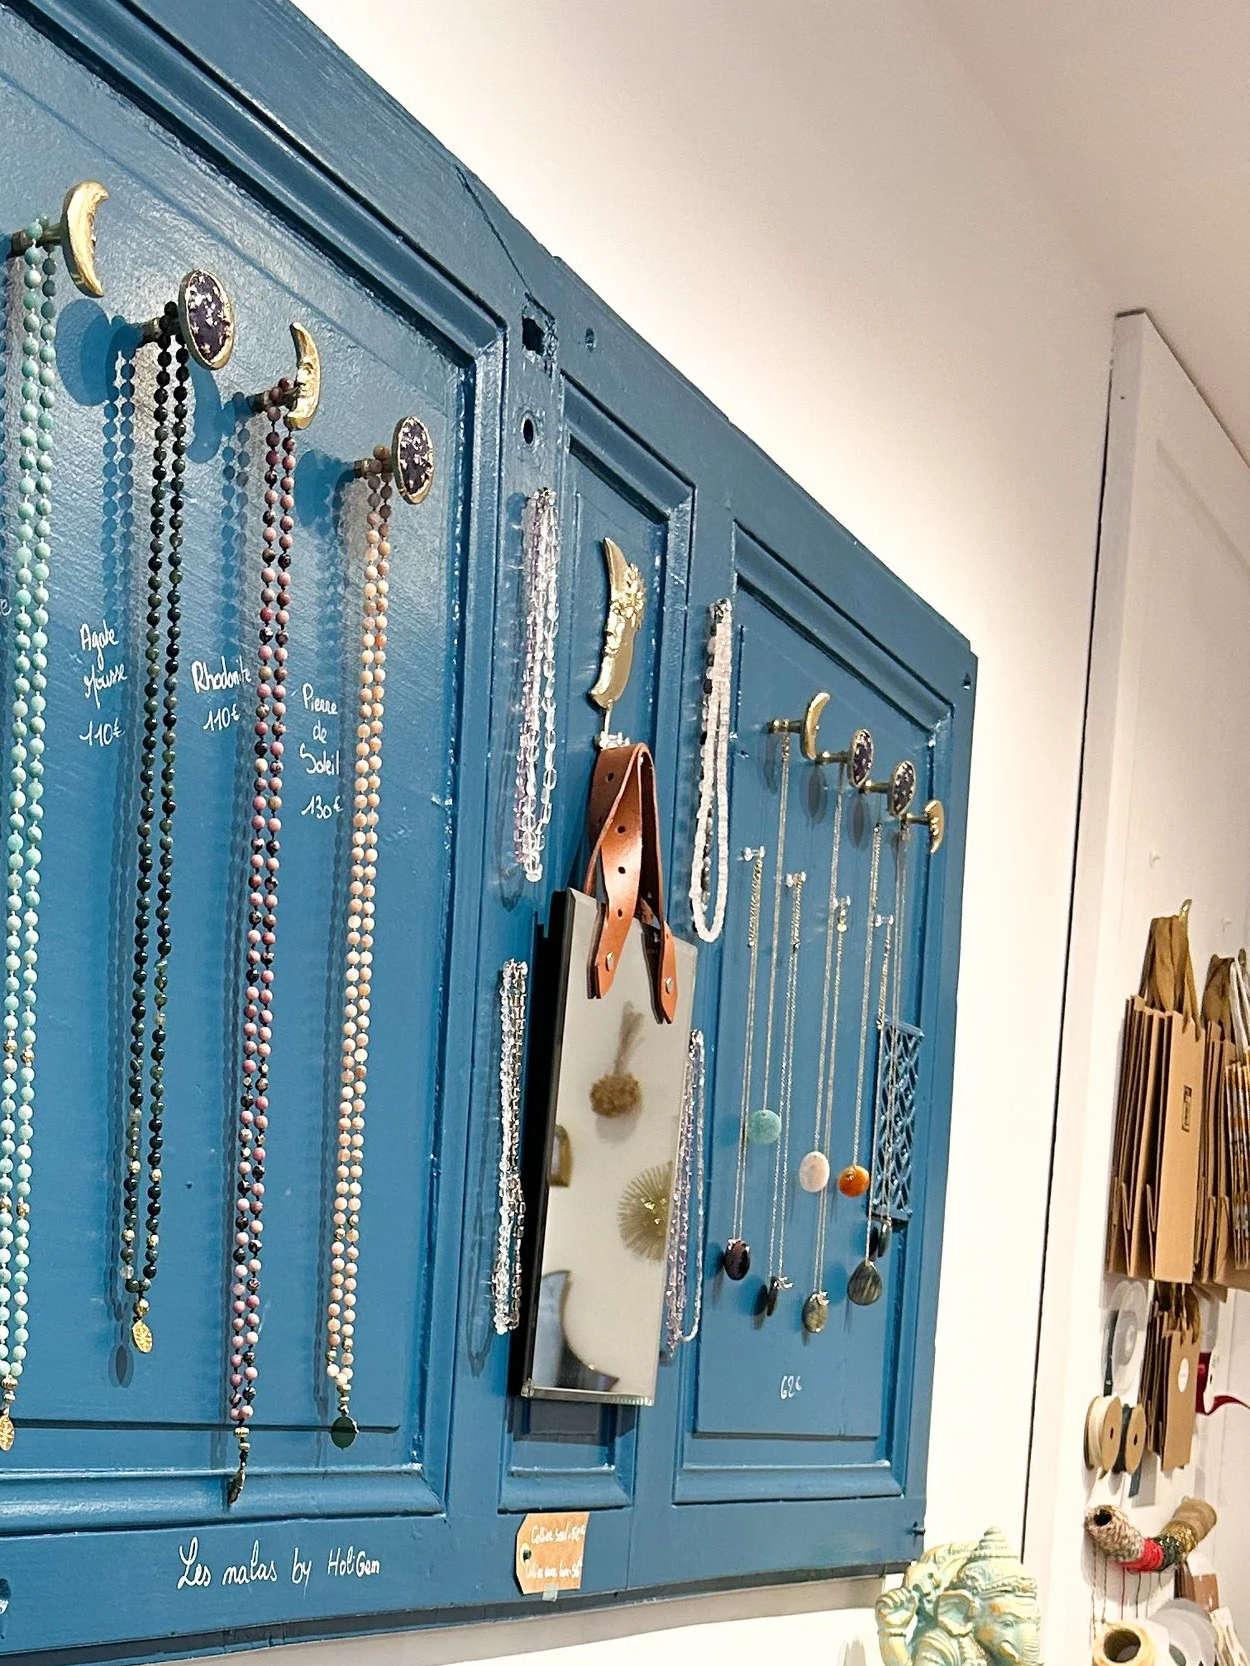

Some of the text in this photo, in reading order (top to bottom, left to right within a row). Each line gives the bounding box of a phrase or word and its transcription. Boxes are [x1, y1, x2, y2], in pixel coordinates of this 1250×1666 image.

[80, 619, 119, 671] Agate
[191, 655, 253, 694] Rhodonite
[302, 682, 339, 715] Pierre
[79, 718, 126, 747] 110€
[203, 704, 241, 732] 110€
[313, 723, 328, 744] de
[299, 743, 340, 776] Soleil
[301, 795, 344, 820] 130€
[177, 1536, 212, 1590] Les
[291, 1547, 313, 1595] by
